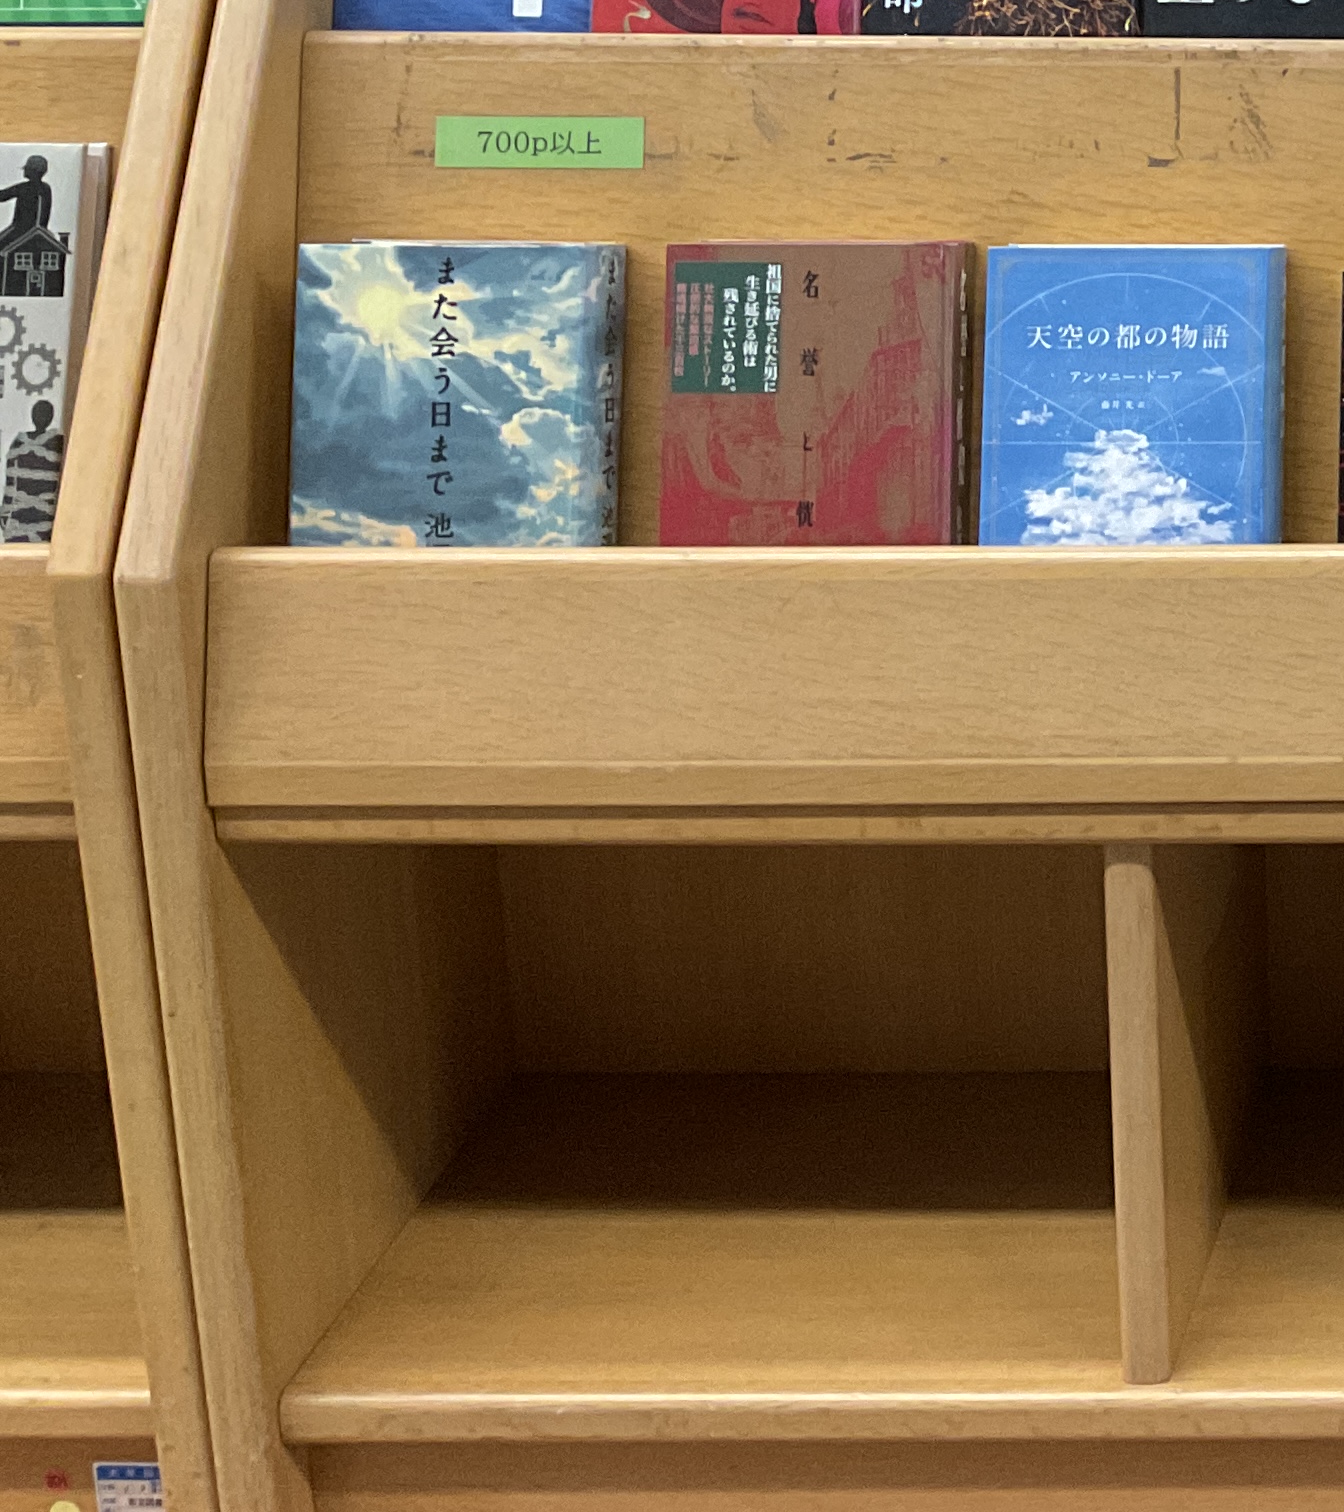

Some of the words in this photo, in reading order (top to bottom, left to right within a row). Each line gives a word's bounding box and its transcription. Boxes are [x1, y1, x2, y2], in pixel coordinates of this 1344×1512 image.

[477, 129, 603, 157] 700p以上
[424, 256, 459, 497] また会う日まで
[720, 287, 740, 392] 残されているのか。
[763, 263, 782, 393] 祖国に捨てられた男に
[1025, 322, 1230, 351] 天空の都の物語
